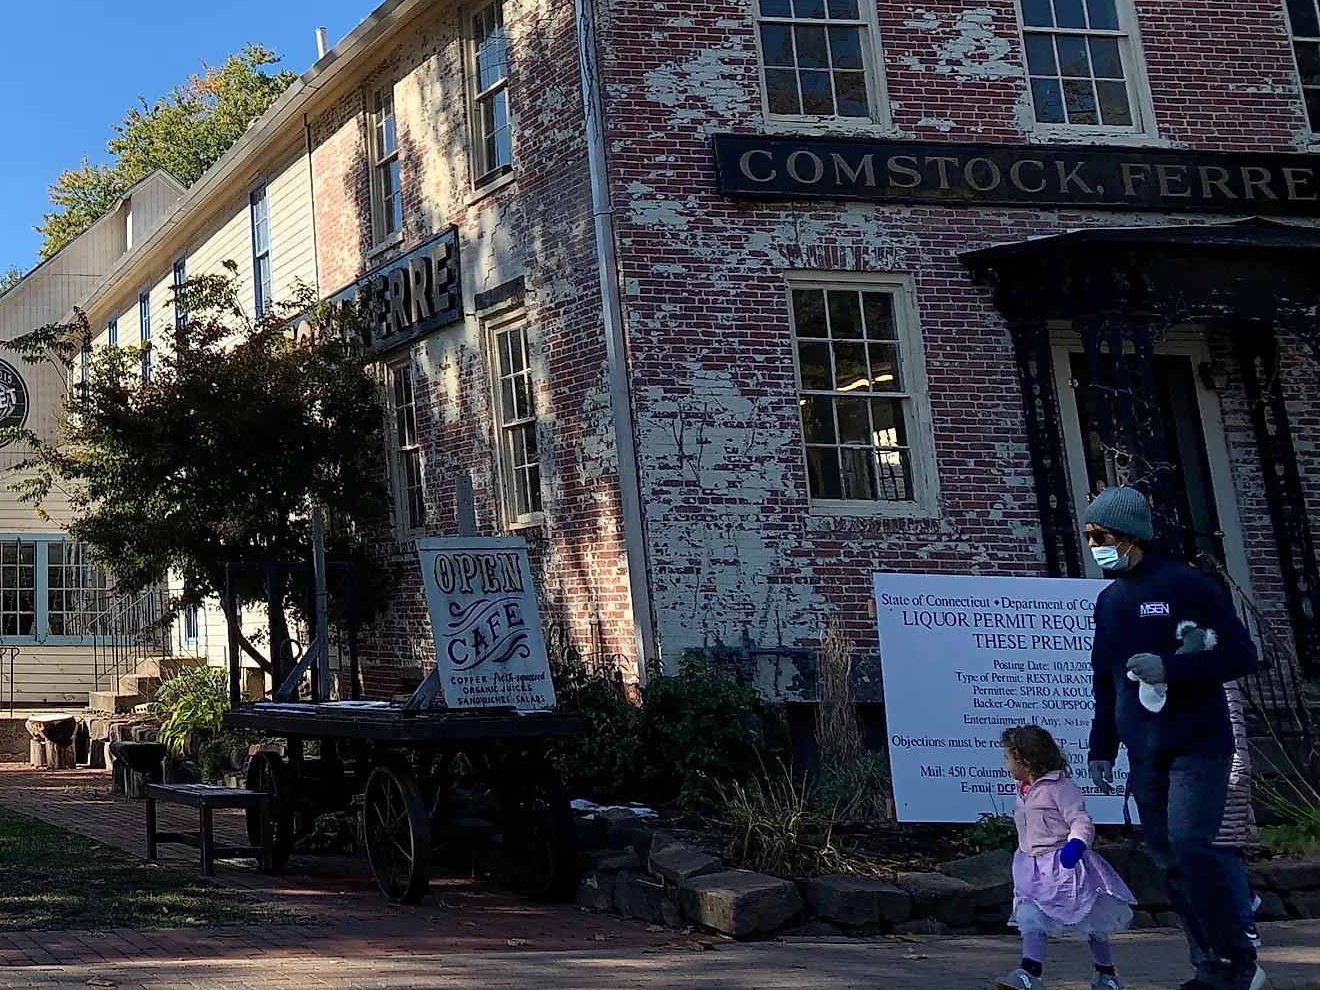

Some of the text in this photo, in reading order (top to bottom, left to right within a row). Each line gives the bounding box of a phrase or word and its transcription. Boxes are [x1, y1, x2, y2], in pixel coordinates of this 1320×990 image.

[739, 149, 1318, 201] COMSTOCK, FERRE
[434, 552, 525, 594] OPEN
[881, 593, 910, 607] State
[911, 595, 925, 607] of
[926, 595, 991, 608] Connecticut
[1001, 597, 1064, 610] Department
[1066, 599, 1078, 610] of
[903, 610, 1095, 633] LIQUOR PERMIT REQUE
[447, 602, 524, 665] CAFE
[972, 633, 1093, 652] THESE PREMIS
[993, 660, 1025, 672] Posting
[1027, 661, 1050, 671] Date:
[450, 675, 488, 685] COFFEE
[955, 672, 979, 684] Type
[980, 672, 990, 683] of
[991, 672, 1023, 683] Permit:
[462, 684, 533, 695] ORGANIC JUICES
[972, 685, 1017, 696] Permittee:
[1020, 686, 1051, 697] SPIRO
[1052, 686, 1061, 697] A
[457, 694, 546, 706] SANDWICHES SALADS
[973, 698, 1095, 710] Backer-Owner: SOUPSPOO
[1031, 715, 1039, 726] If
[1064, 717, 1075, 726] No
[891, 735, 946, 749] Objections
[948, 738, 973, 748] must
[974, 736, 987, 748] be
[920, 765, 946, 778] Mail:
[948, 766, 966, 778] 450
[968, 767, 1012, 779] Columb
